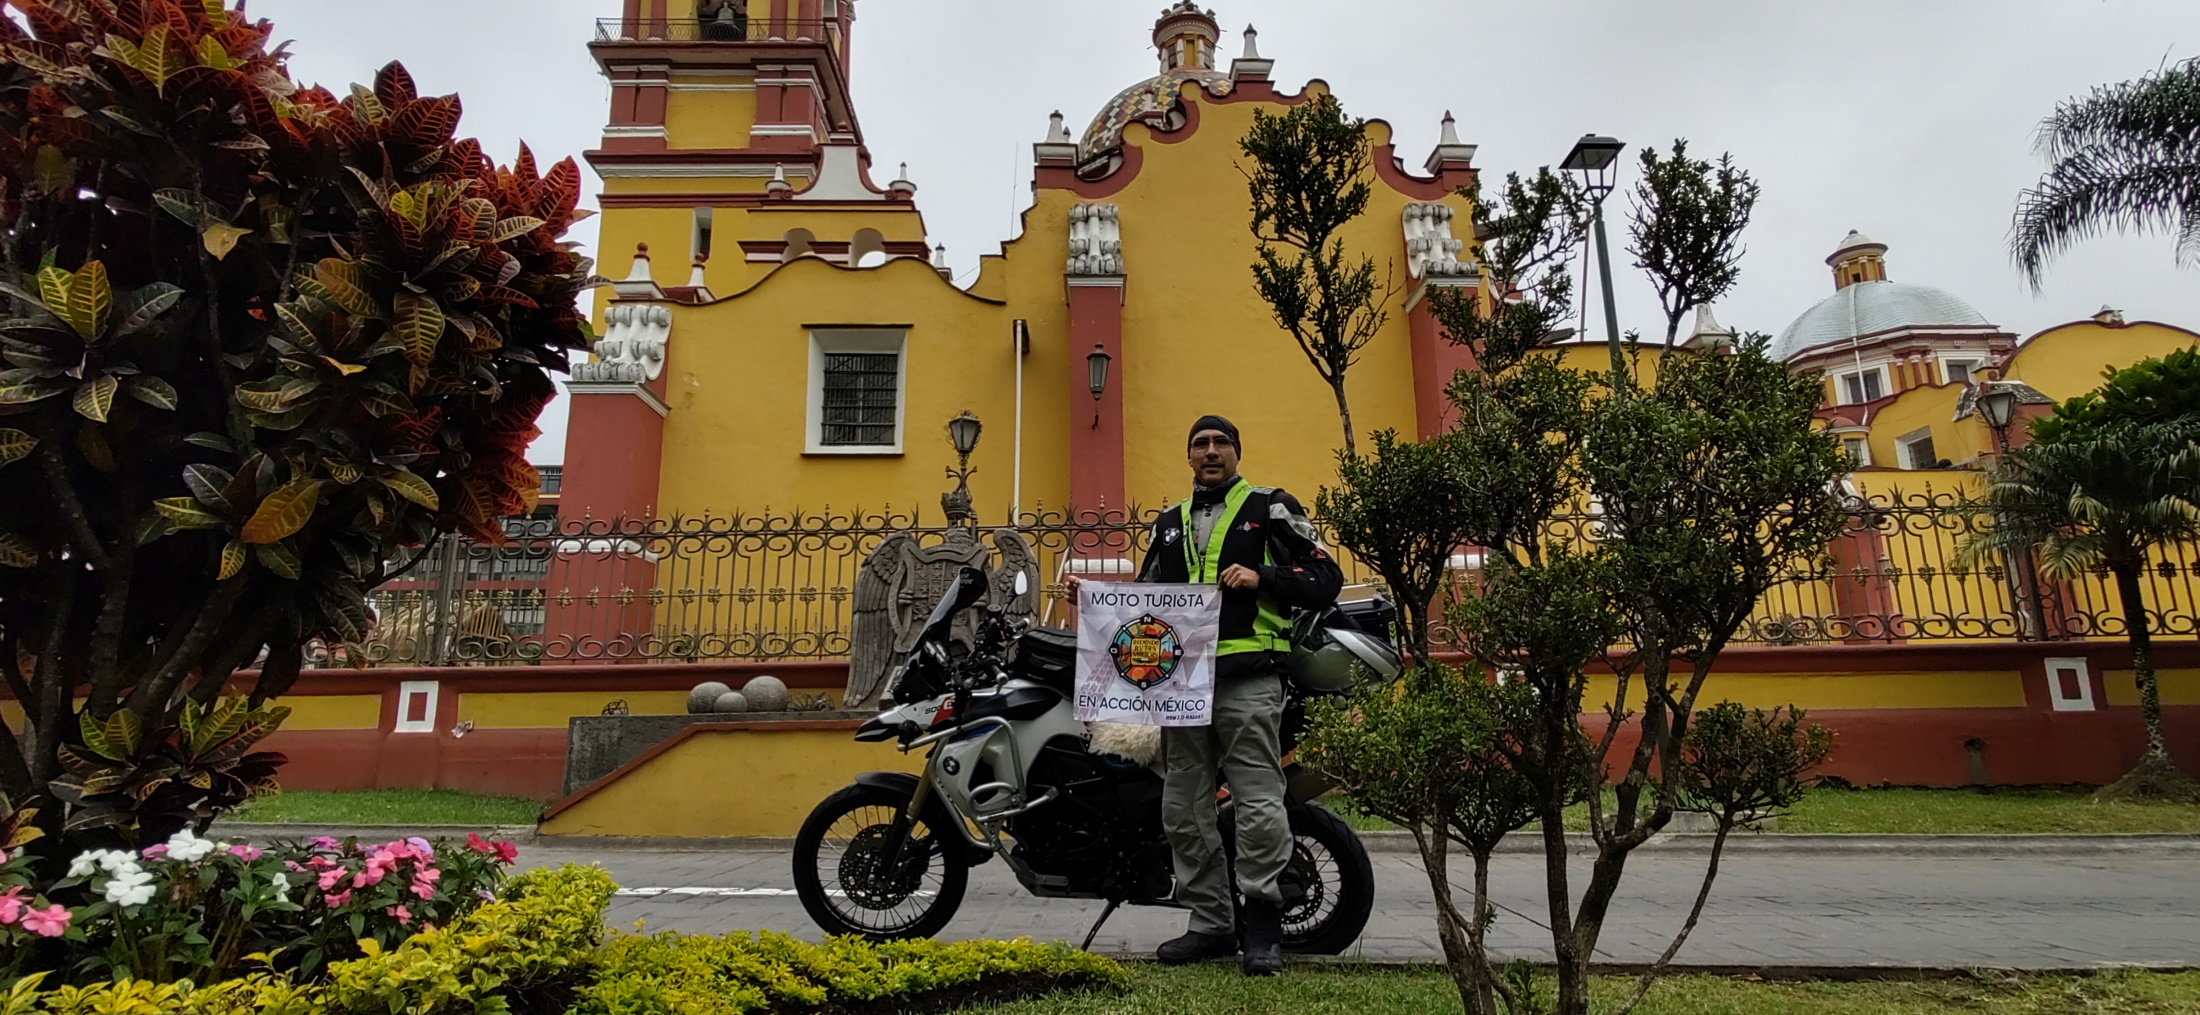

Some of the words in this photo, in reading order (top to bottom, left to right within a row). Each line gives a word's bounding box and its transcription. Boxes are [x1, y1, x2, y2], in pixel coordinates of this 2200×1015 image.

[1091, 592, 1140, 607] MOTO
[1144, 593, 1204, 608] TURISTA
[1078, 695, 1097, 708] EN
[1099, 695, 1152, 712] ACCIÓN
[1154, 696, 1206, 713] MÉXICO
